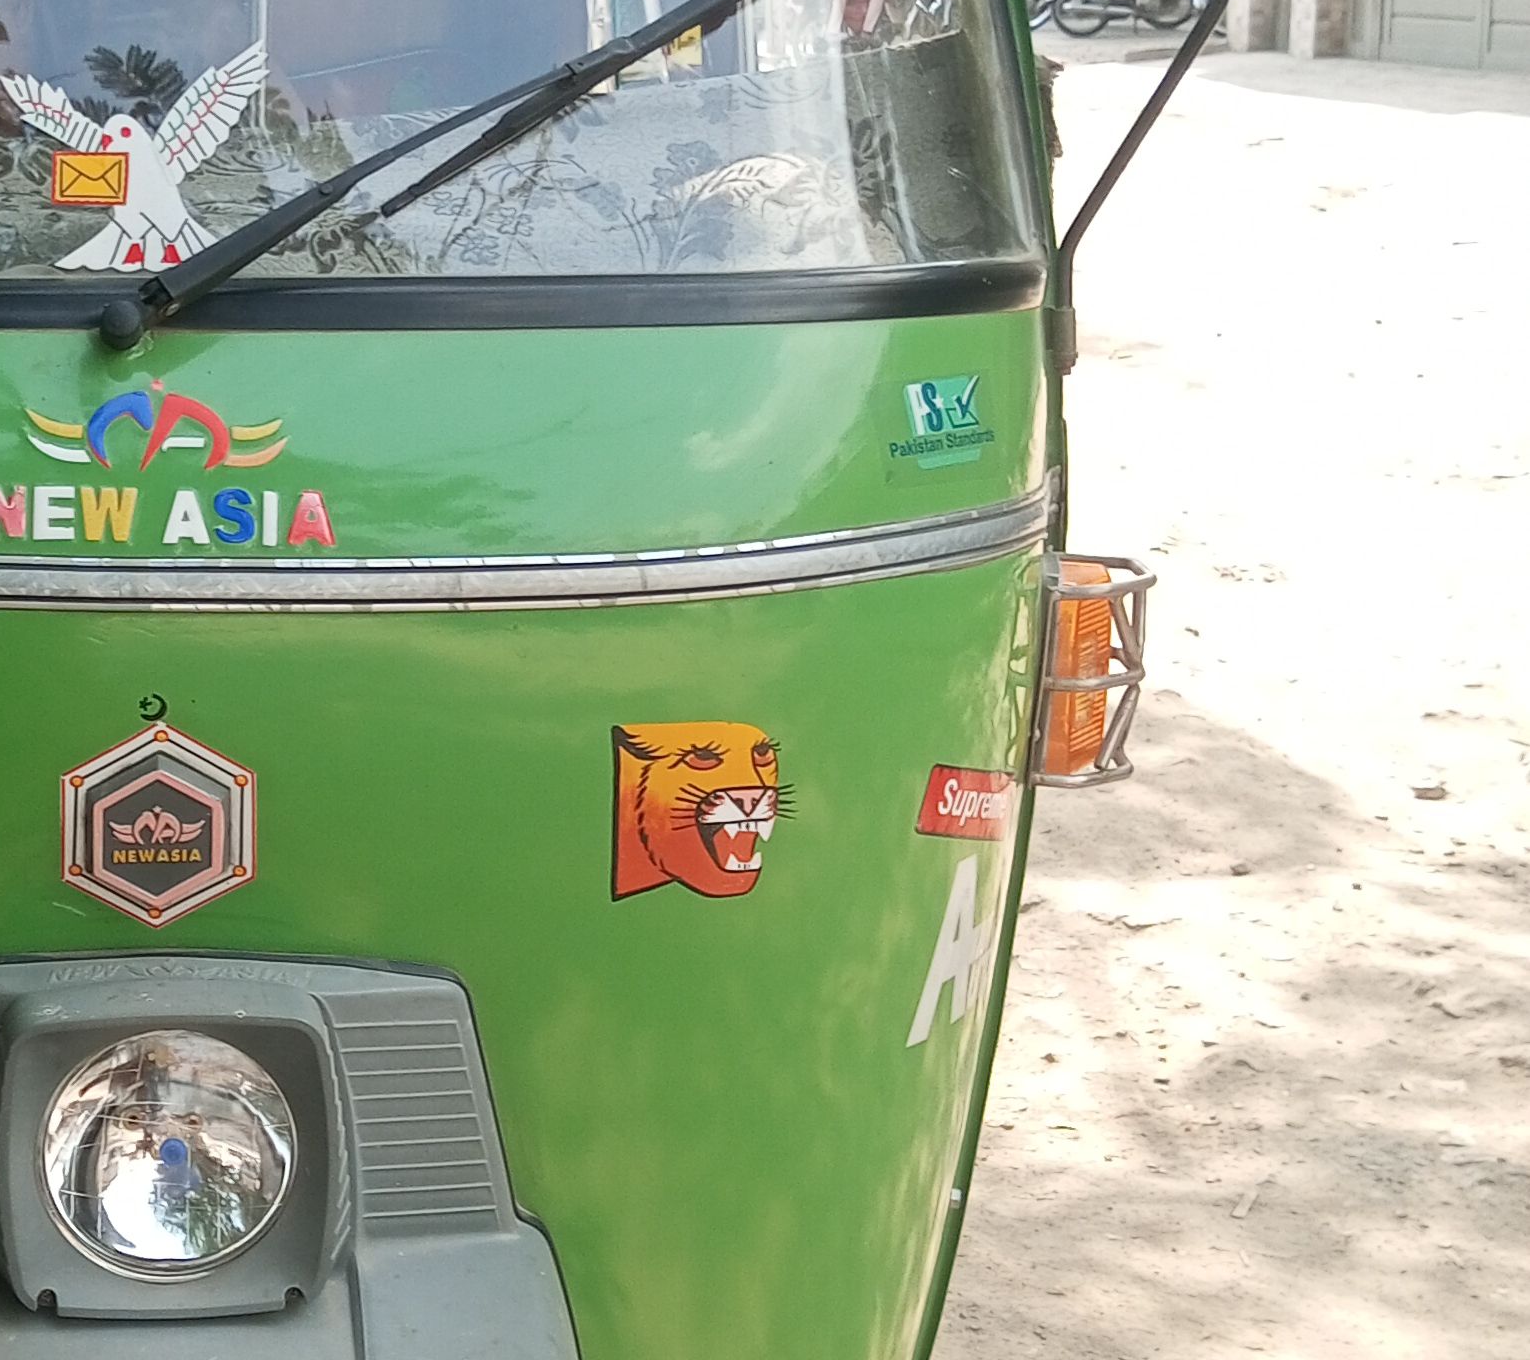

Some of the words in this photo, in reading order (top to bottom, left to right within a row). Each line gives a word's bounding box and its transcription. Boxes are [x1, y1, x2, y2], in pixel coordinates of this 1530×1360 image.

[890, 438, 944, 458] Pakistan
[946, 430, 995, 449] Standards
[161, 488, 336, 547] ASIA
